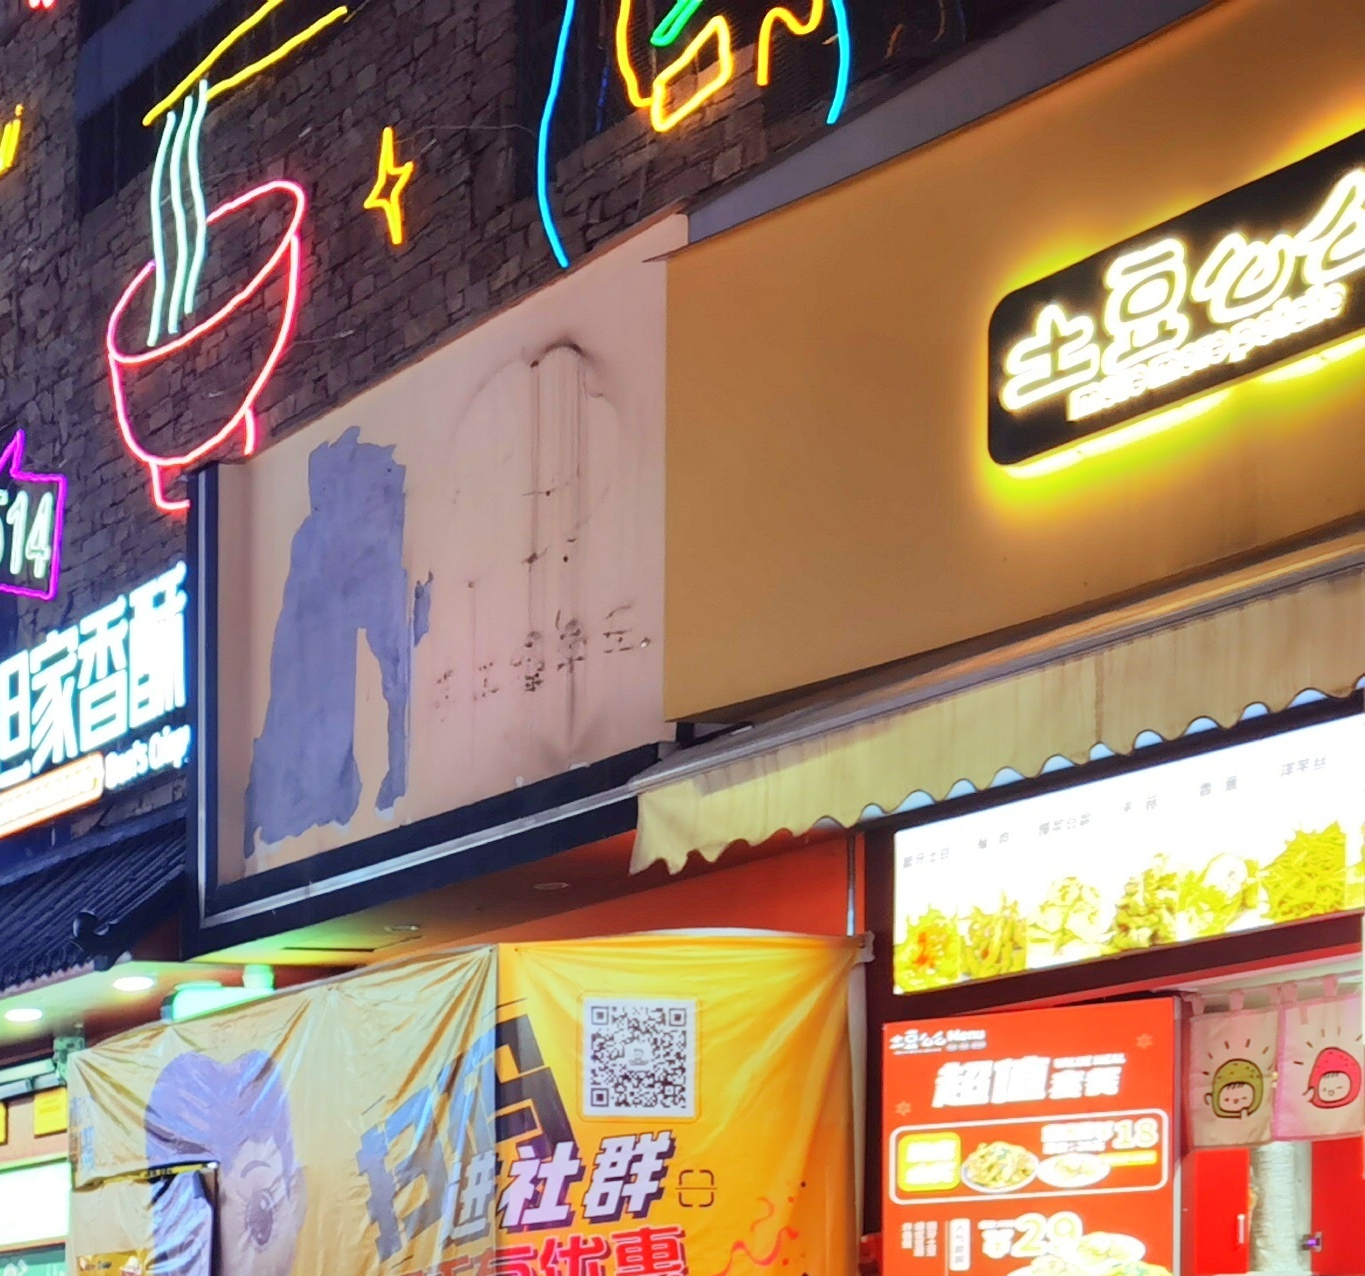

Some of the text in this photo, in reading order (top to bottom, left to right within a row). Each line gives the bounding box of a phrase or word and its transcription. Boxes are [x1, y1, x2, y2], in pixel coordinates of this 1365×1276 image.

[931, 1055, 1052, 1108] 超值
[447, 1129, 674, 1240] 进社群
